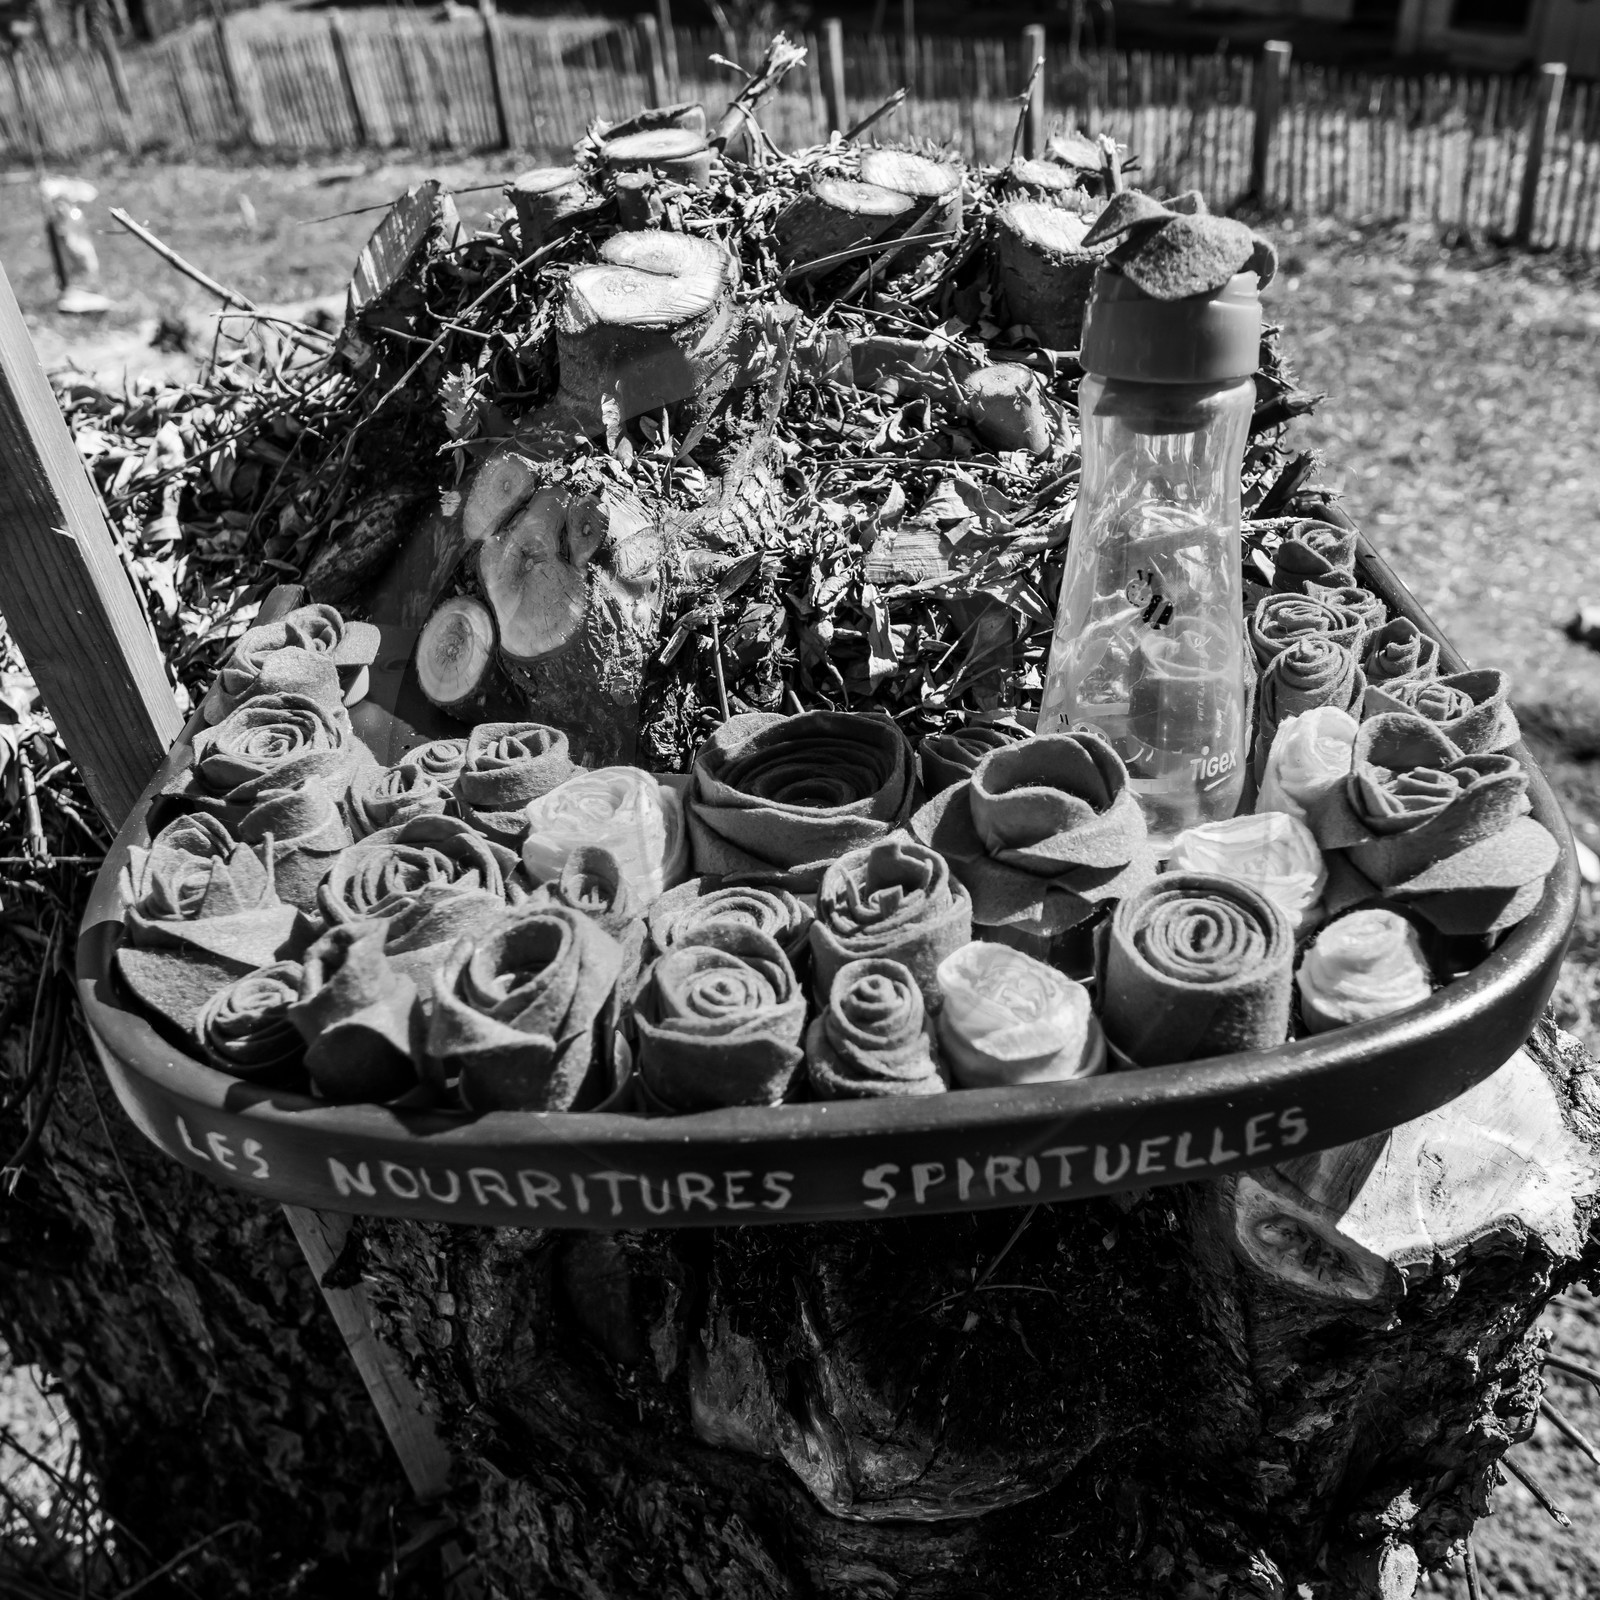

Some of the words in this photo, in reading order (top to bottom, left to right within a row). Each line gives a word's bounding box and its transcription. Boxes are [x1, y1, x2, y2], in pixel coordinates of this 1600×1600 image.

[175, 1115, 270, 1179] LES
[327, 1157, 794, 1216] NOURRITURES
[863, 1107, 1308, 1210] SPIRITUELLES
